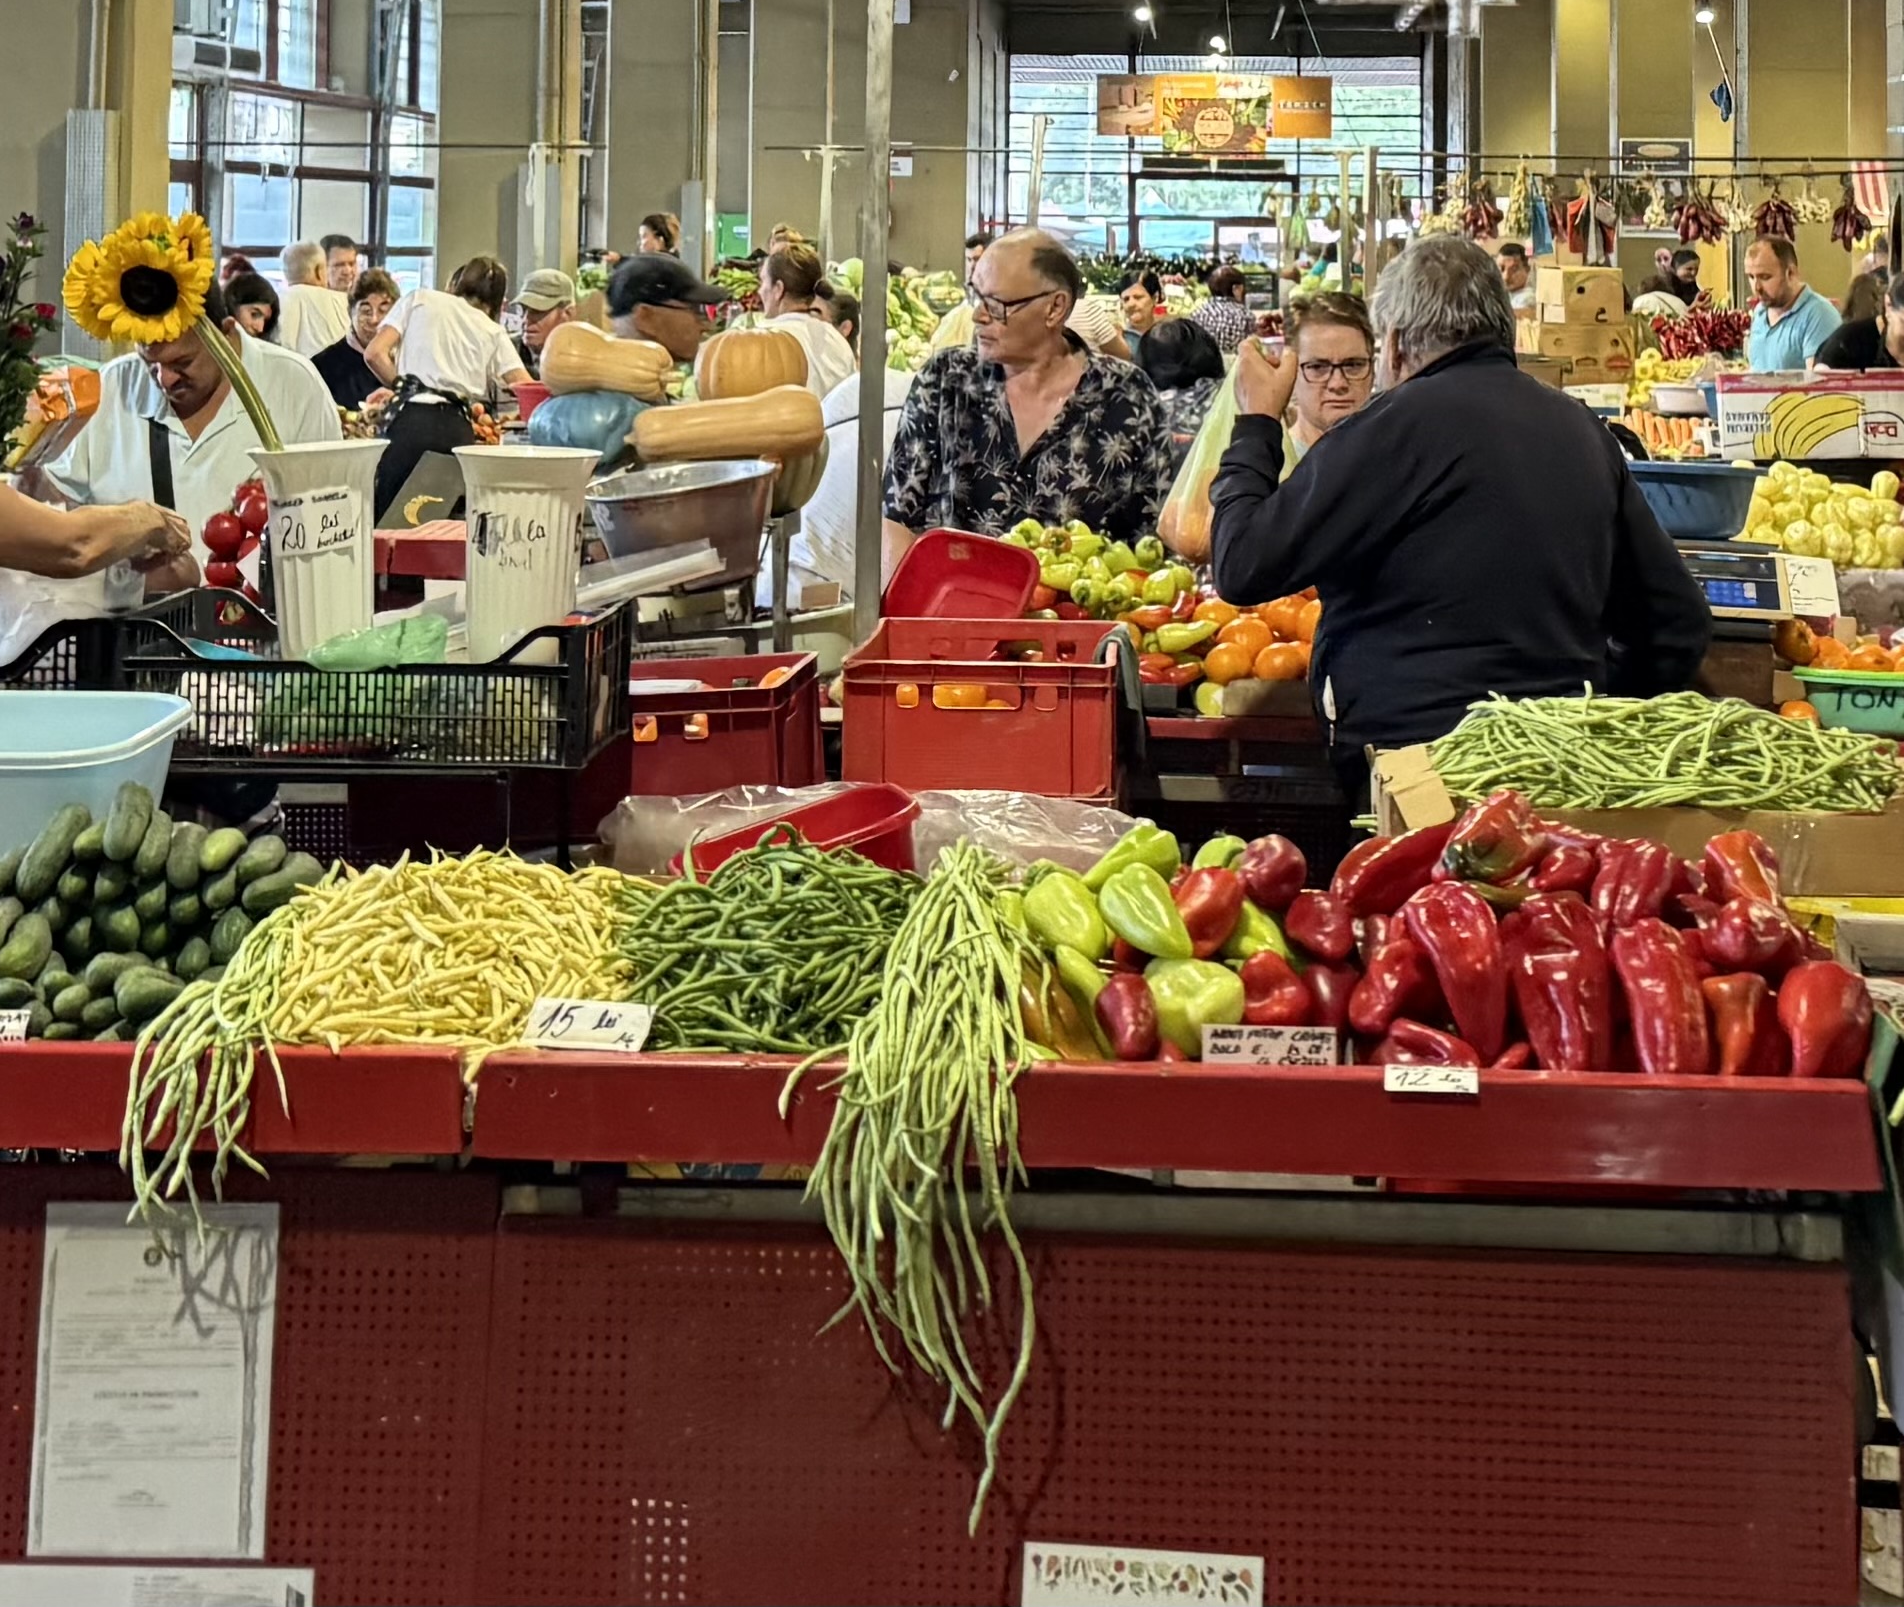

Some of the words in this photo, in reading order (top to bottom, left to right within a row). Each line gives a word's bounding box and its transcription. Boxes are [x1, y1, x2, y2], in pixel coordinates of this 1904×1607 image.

[281, 515, 306, 552] 20
[537, 1002, 585, 1039] 15
[1394, 1071, 1430, 1087] 12
